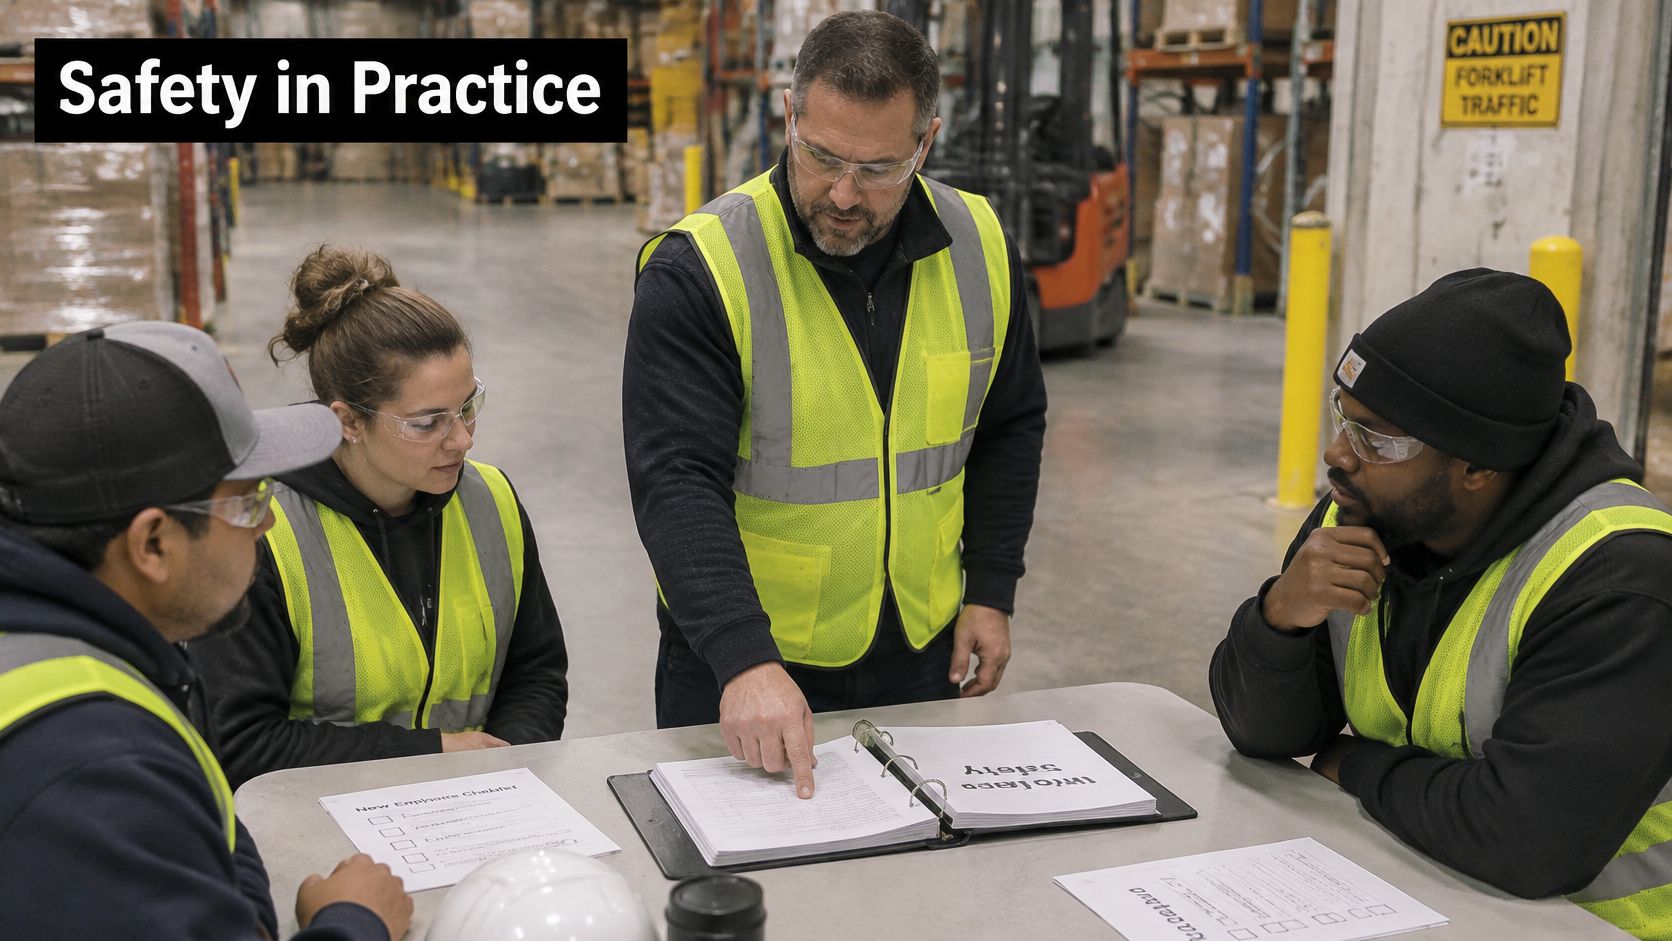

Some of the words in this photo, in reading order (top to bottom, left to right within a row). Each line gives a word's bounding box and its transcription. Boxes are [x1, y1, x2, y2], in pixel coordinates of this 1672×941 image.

[1451, 21, 1559, 56] CAUTION
[1455, 64, 1548, 87] FORKLIFT
[1460, 93, 1538, 117] TRAFFIC
